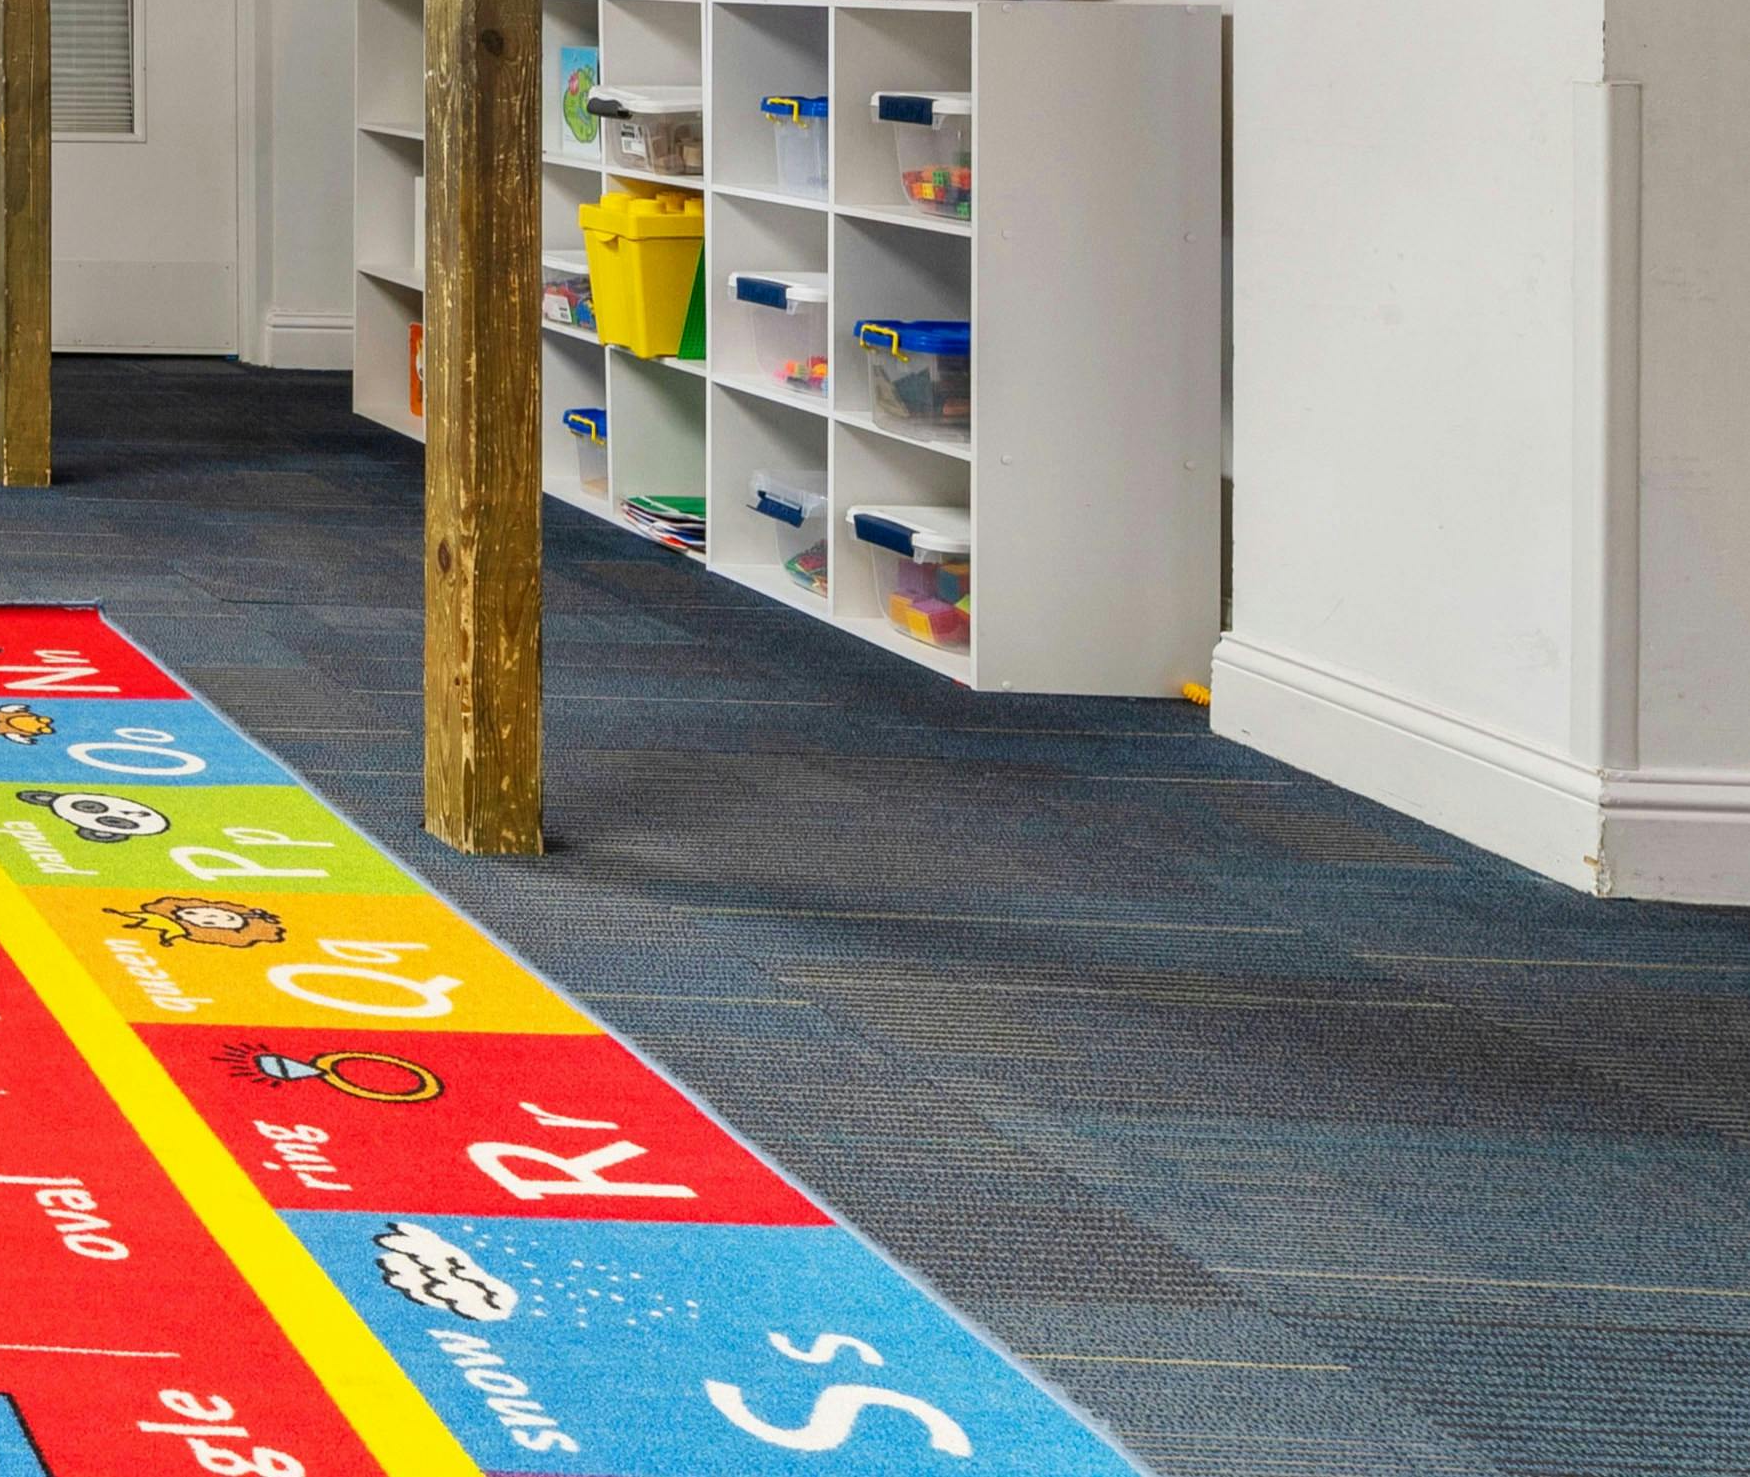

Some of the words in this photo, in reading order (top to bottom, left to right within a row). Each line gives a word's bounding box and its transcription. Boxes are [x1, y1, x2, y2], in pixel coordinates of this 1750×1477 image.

[3, 819, 99, 877] panda
[102, 937, 208, 1014] queen
[254, 1120, 353, 1193] ring
[427, 1329, 580, 1453] snow
